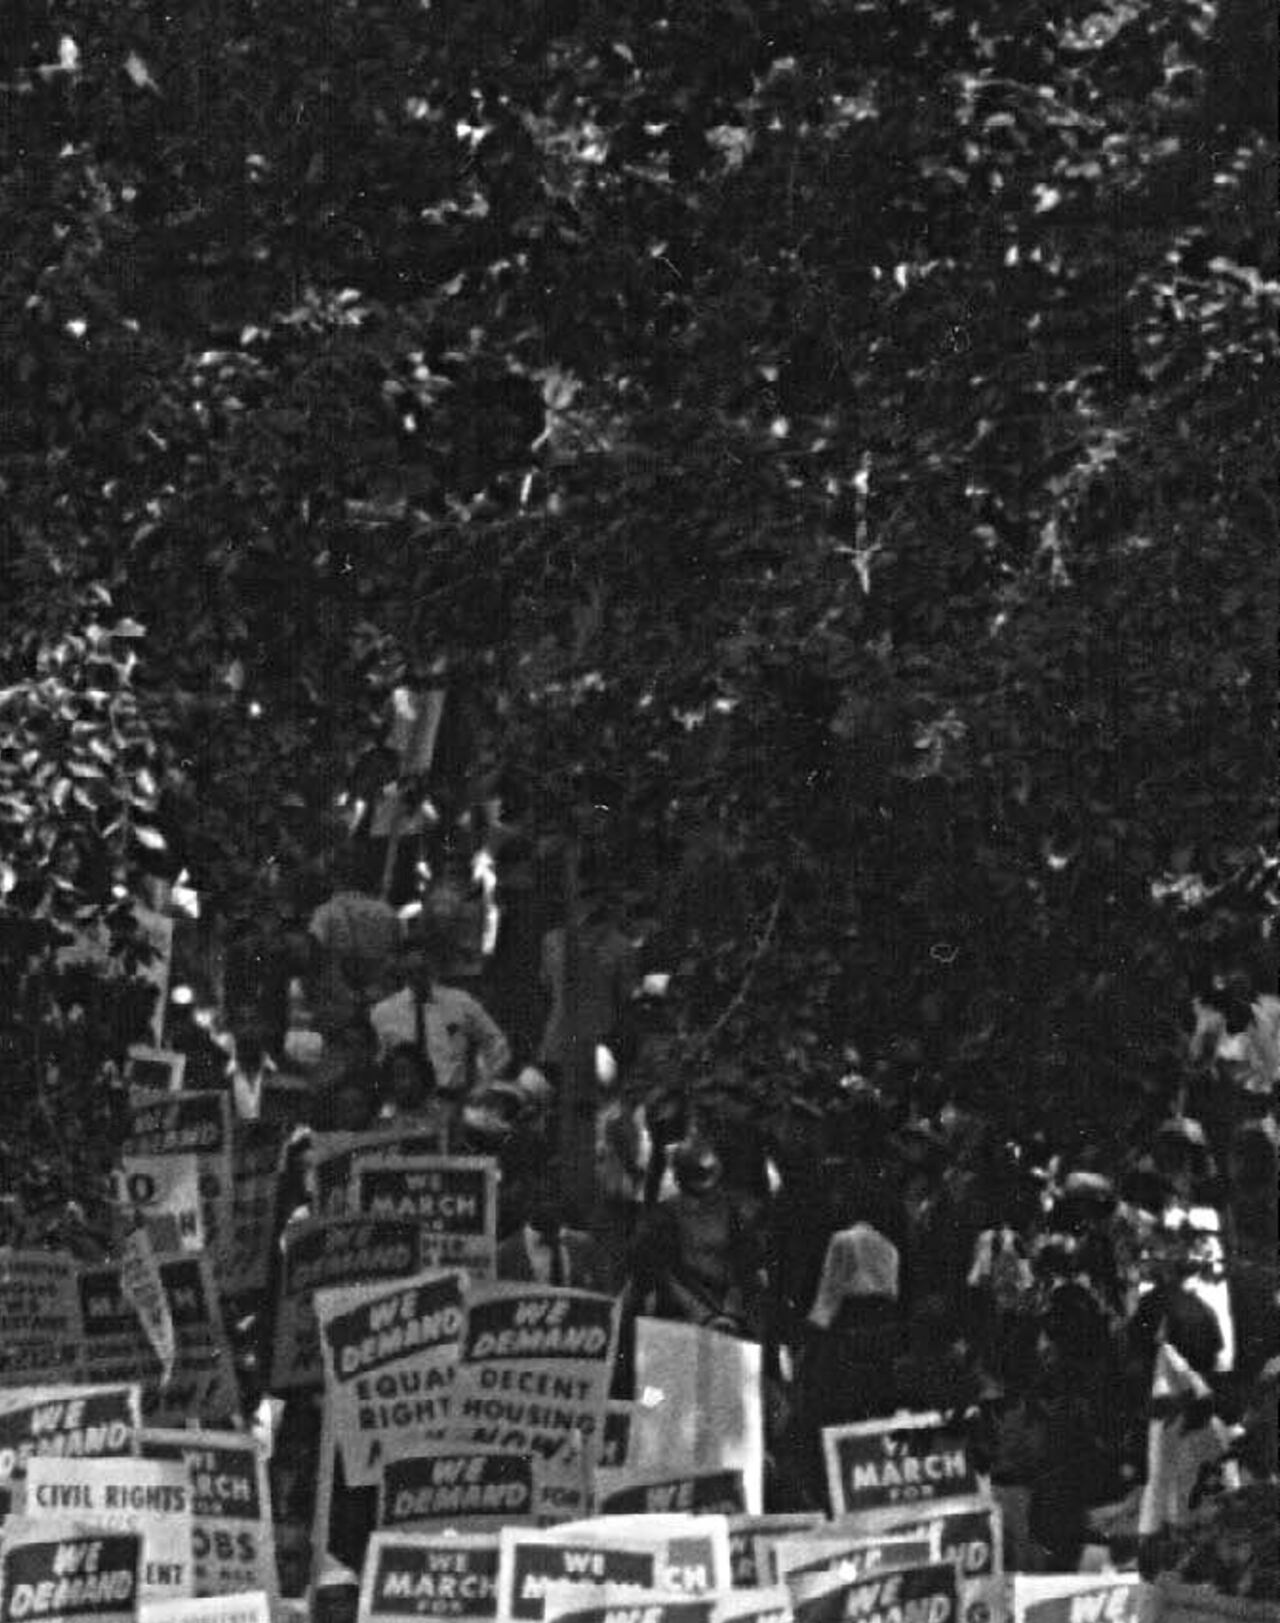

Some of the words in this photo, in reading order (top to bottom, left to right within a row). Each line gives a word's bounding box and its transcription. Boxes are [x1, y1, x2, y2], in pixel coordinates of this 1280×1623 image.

[370, 1195, 474, 1216] MARCH
[474, 1328, 605, 1353] DEMAND
[481, 1370, 590, 1396] DECENT
[464, 1400, 595, 1432] HOUSING
[852, 1454, 966, 1488] MARCH
[37, 1486, 95, 1511] CIVIL
[106, 1484, 185, 1512] RIGHTS
[54, 1541, 106, 1574] WE
[10, 1569, 129, 1618] DEMAND
[385, 1574, 497, 1598] MARCH
